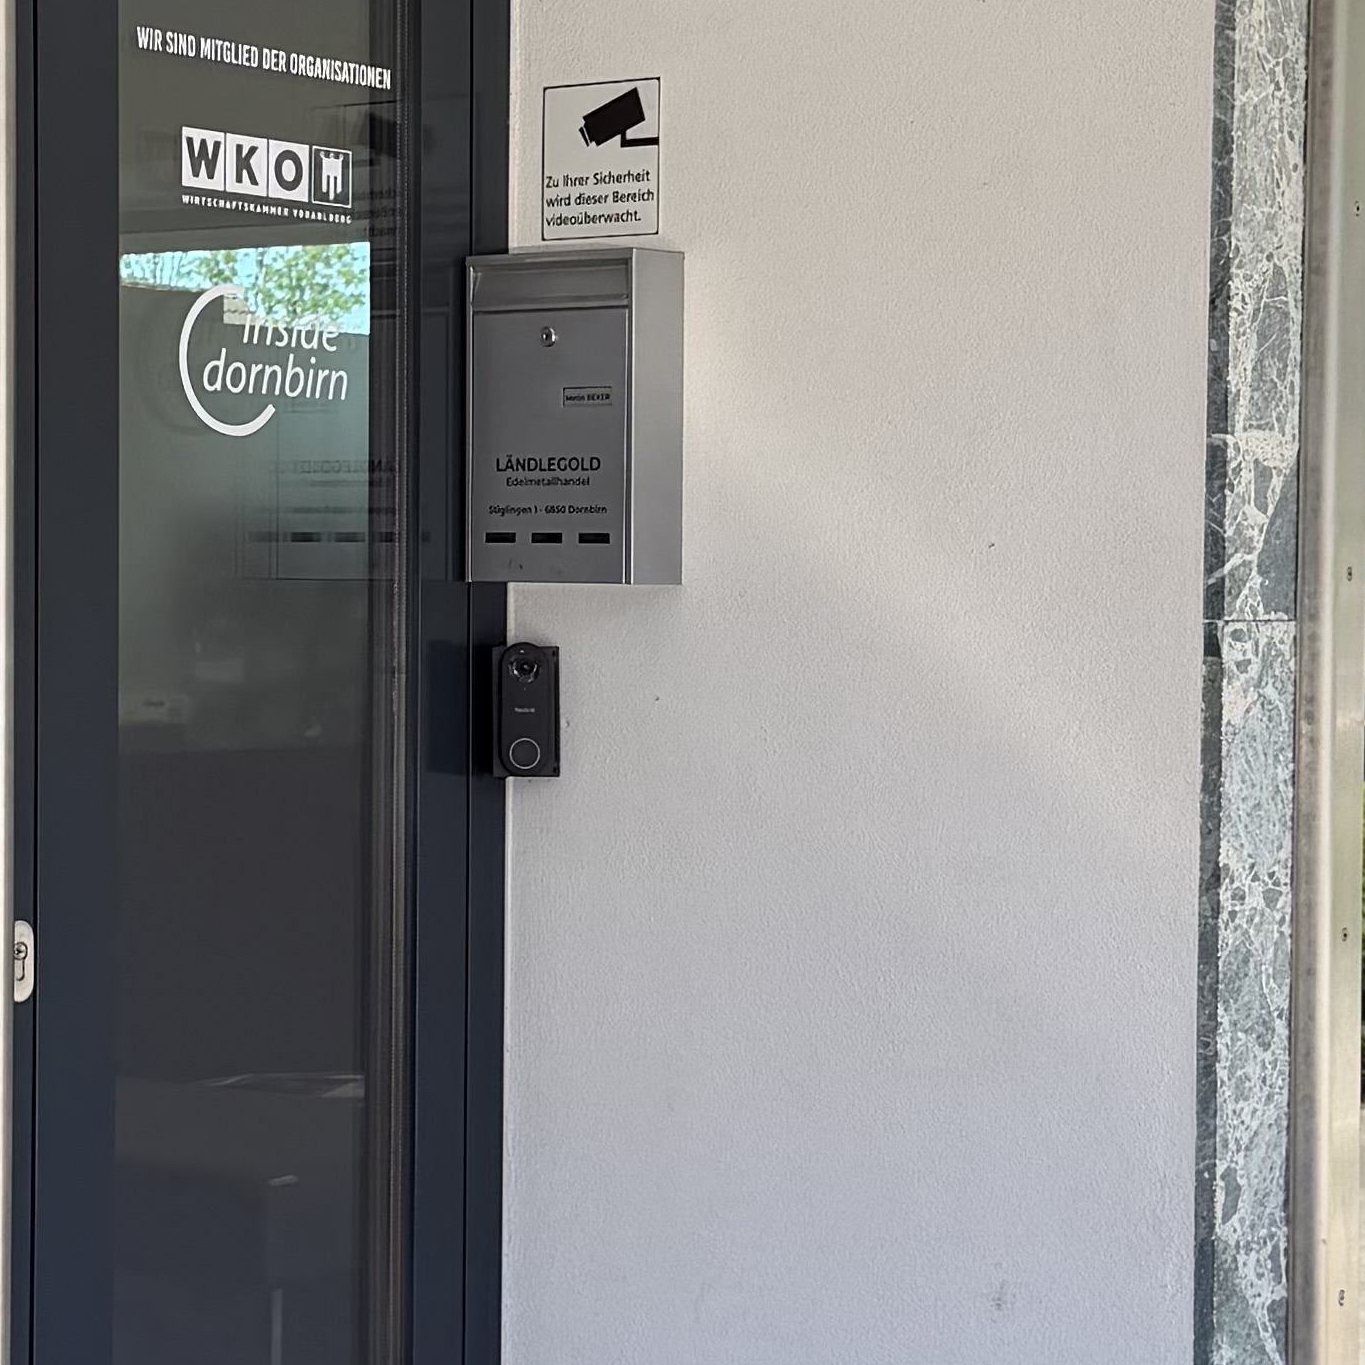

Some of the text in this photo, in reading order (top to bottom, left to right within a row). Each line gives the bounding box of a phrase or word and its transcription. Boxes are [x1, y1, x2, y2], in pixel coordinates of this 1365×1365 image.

[136, 26, 392, 90] WIR SIND MITGLIED DER ORGANISATIONEN
[186, 136, 304, 192] WKO
[545, 169, 651, 188] Zu Ihrer Sicherheit
[545, 188, 655, 208] wird dieser Bereich
[545, 209, 642, 227] videoüberwacht.
[202, 347, 348, 401] dornbirn
[496, 454, 601, 473] LÄNDLEGOLD
[506, 476, 590, 487] Edelmetallhandel
